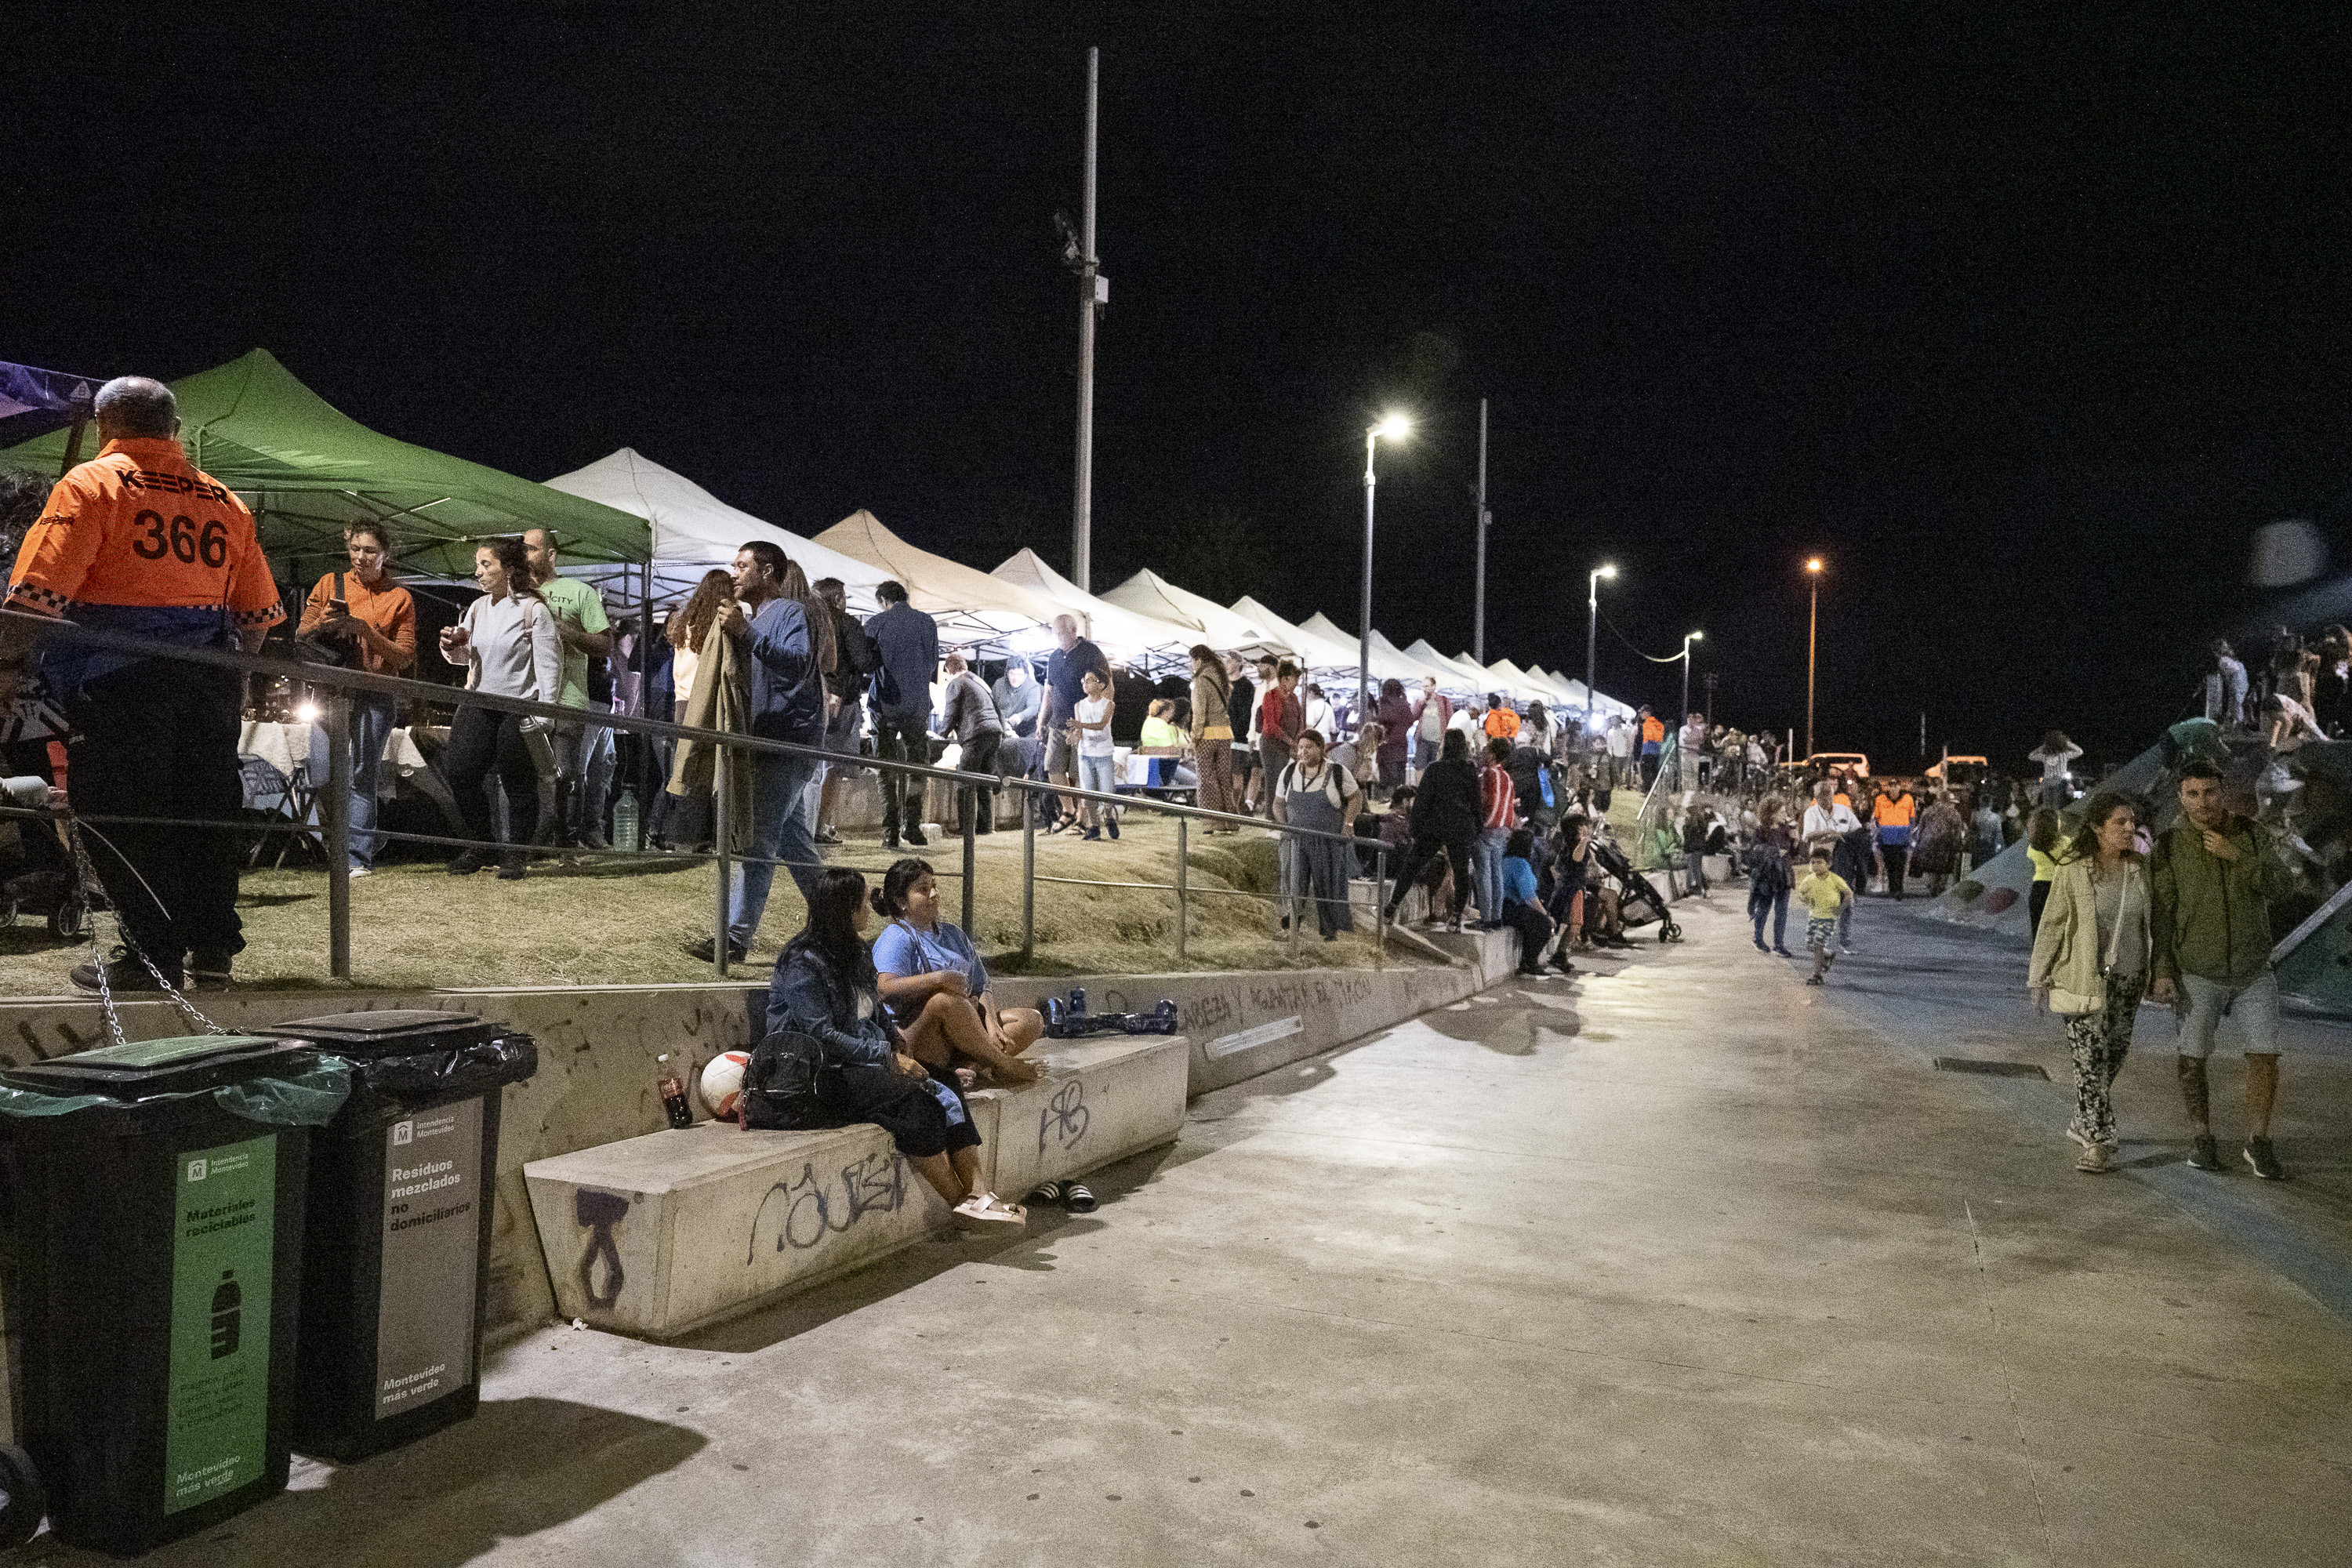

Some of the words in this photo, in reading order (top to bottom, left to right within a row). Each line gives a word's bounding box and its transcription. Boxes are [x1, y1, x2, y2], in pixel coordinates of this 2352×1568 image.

[116, 470, 230, 505] KEEPER
[132, 510, 229, 568] 366
[416, 1116, 454, 1130] Intendencia
[416, 1124, 455, 1138] Montevideo
[210, 1163, 249, 1174] Montevideo
[211, 1153, 249, 1167] Intendencia
[392, 1160, 453, 1182] Residuos
[391, 1174, 461, 1199] mezclados
[186, 1199, 255, 1223] Materiales
[390, 1202, 470, 1232] domiciliarios
[391, 1203, 409, 1215] no
[186, 1213, 256, 1237] reciclables
[383, 1363, 445, 1391] Montevideo
[382, 1388, 407, 1405] más
[411, 1378, 439, 1396] verde
[176, 1454, 241, 1485] Montevideo
[176, 1480, 201, 1497] más
[204, 1468, 234, 1488] verde
